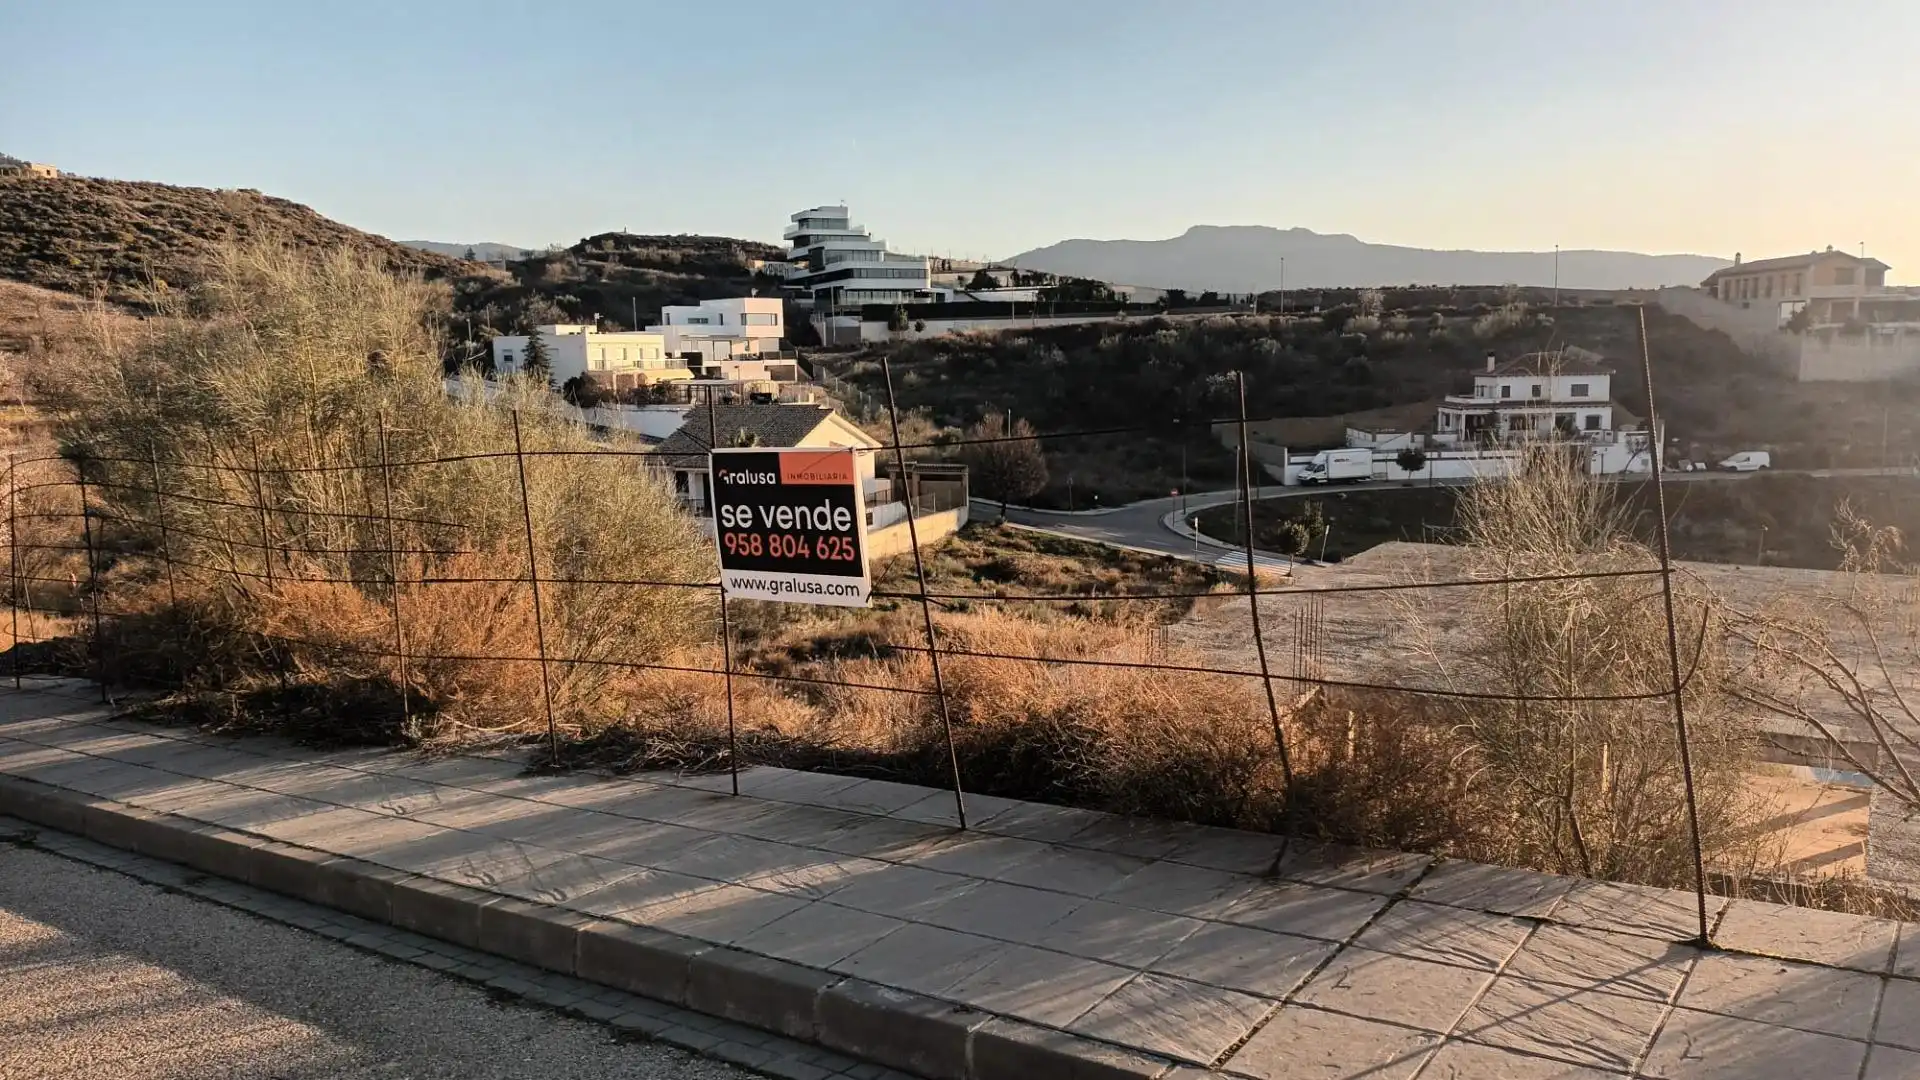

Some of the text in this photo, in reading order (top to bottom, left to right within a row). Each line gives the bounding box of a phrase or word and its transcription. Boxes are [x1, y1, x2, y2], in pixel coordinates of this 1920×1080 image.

[719, 469, 776, 485] Gralusa
[787, 473, 848, 481] INMOBILIARIA
[721, 499, 851, 532] se vende
[724, 532, 856, 561] 958 804 625
[730, 577, 860, 597] www.gralusa.com
